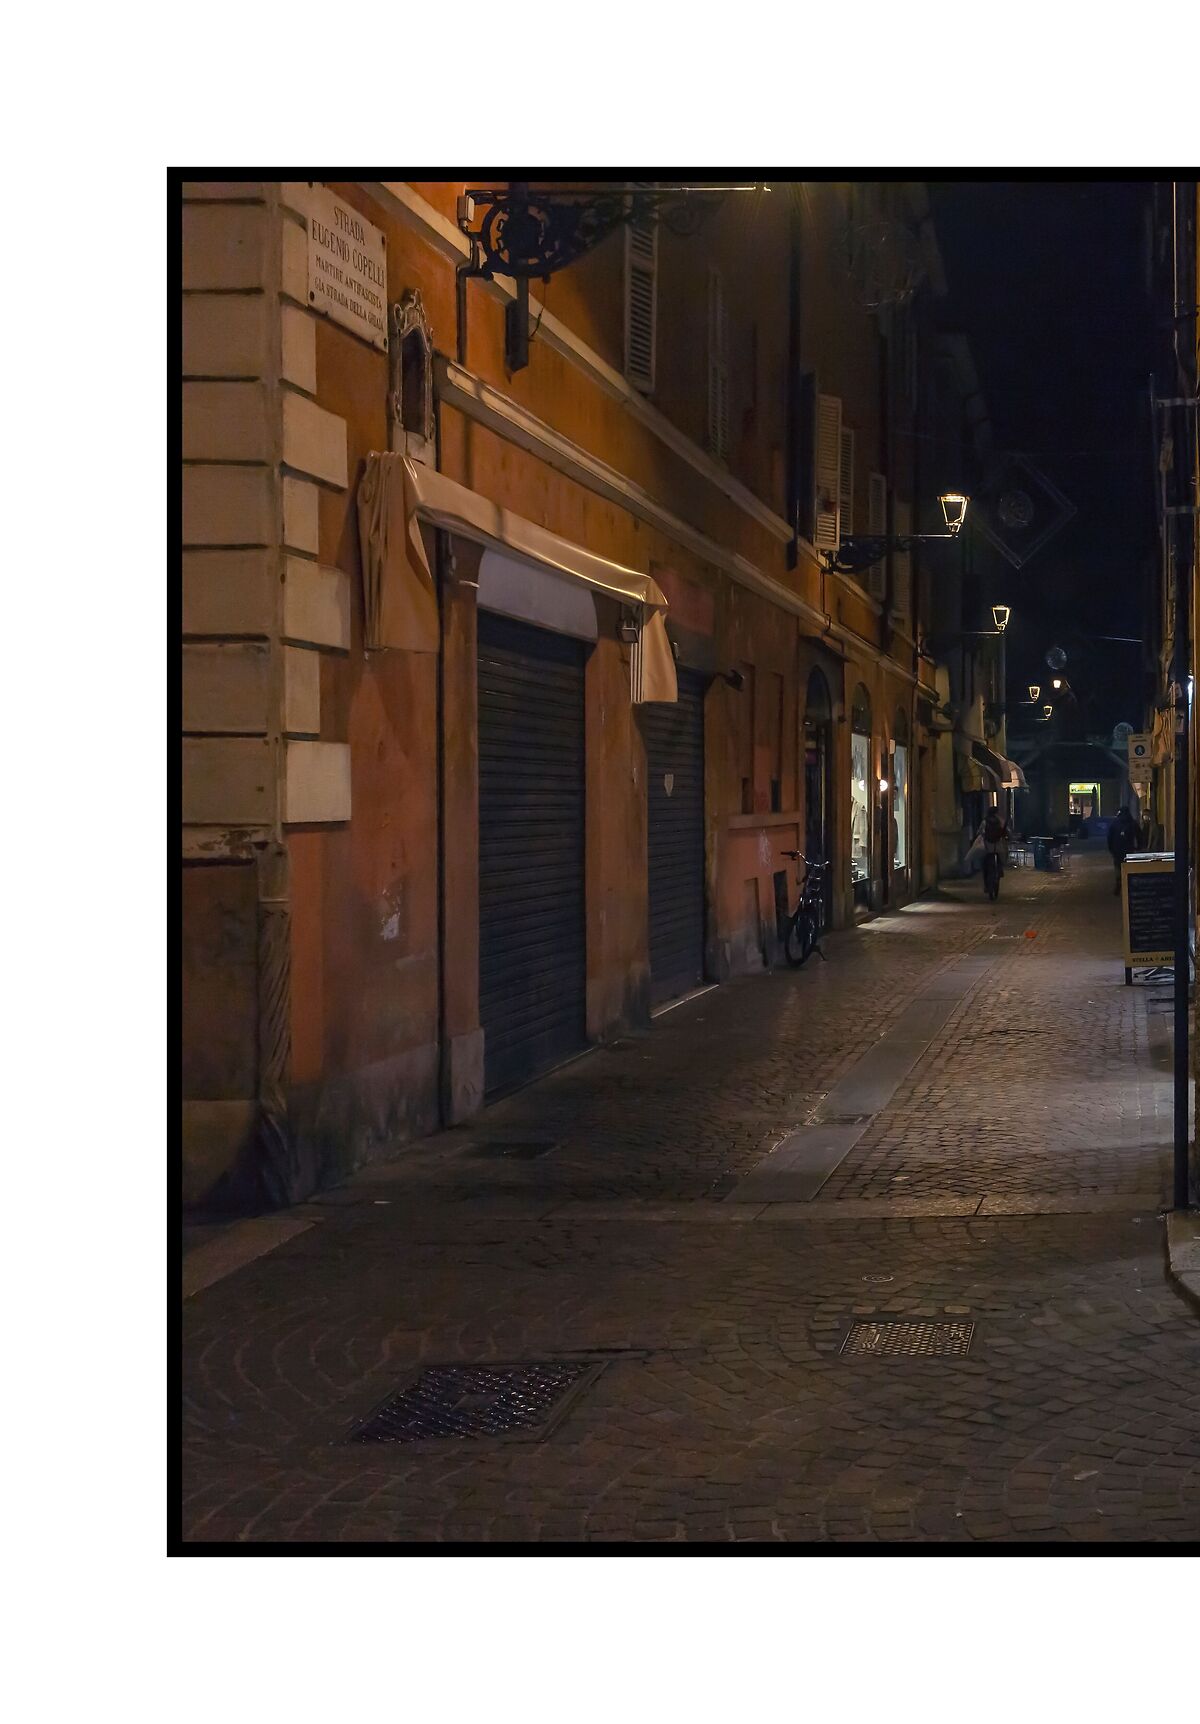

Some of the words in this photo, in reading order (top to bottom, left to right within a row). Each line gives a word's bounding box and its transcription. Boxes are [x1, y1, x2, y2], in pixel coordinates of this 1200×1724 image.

[334, 206, 365, 246] STRADA
[312, 218, 350, 263] EUGENIO
[352, 248, 385, 289] COPELLI
[315, 255, 344, 283] MARTIRE
[345, 276, 383, 311] ANTIFASCISTA
[326, 284, 349, 308] STRADA
[349, 299, 367, 321] DELLA
